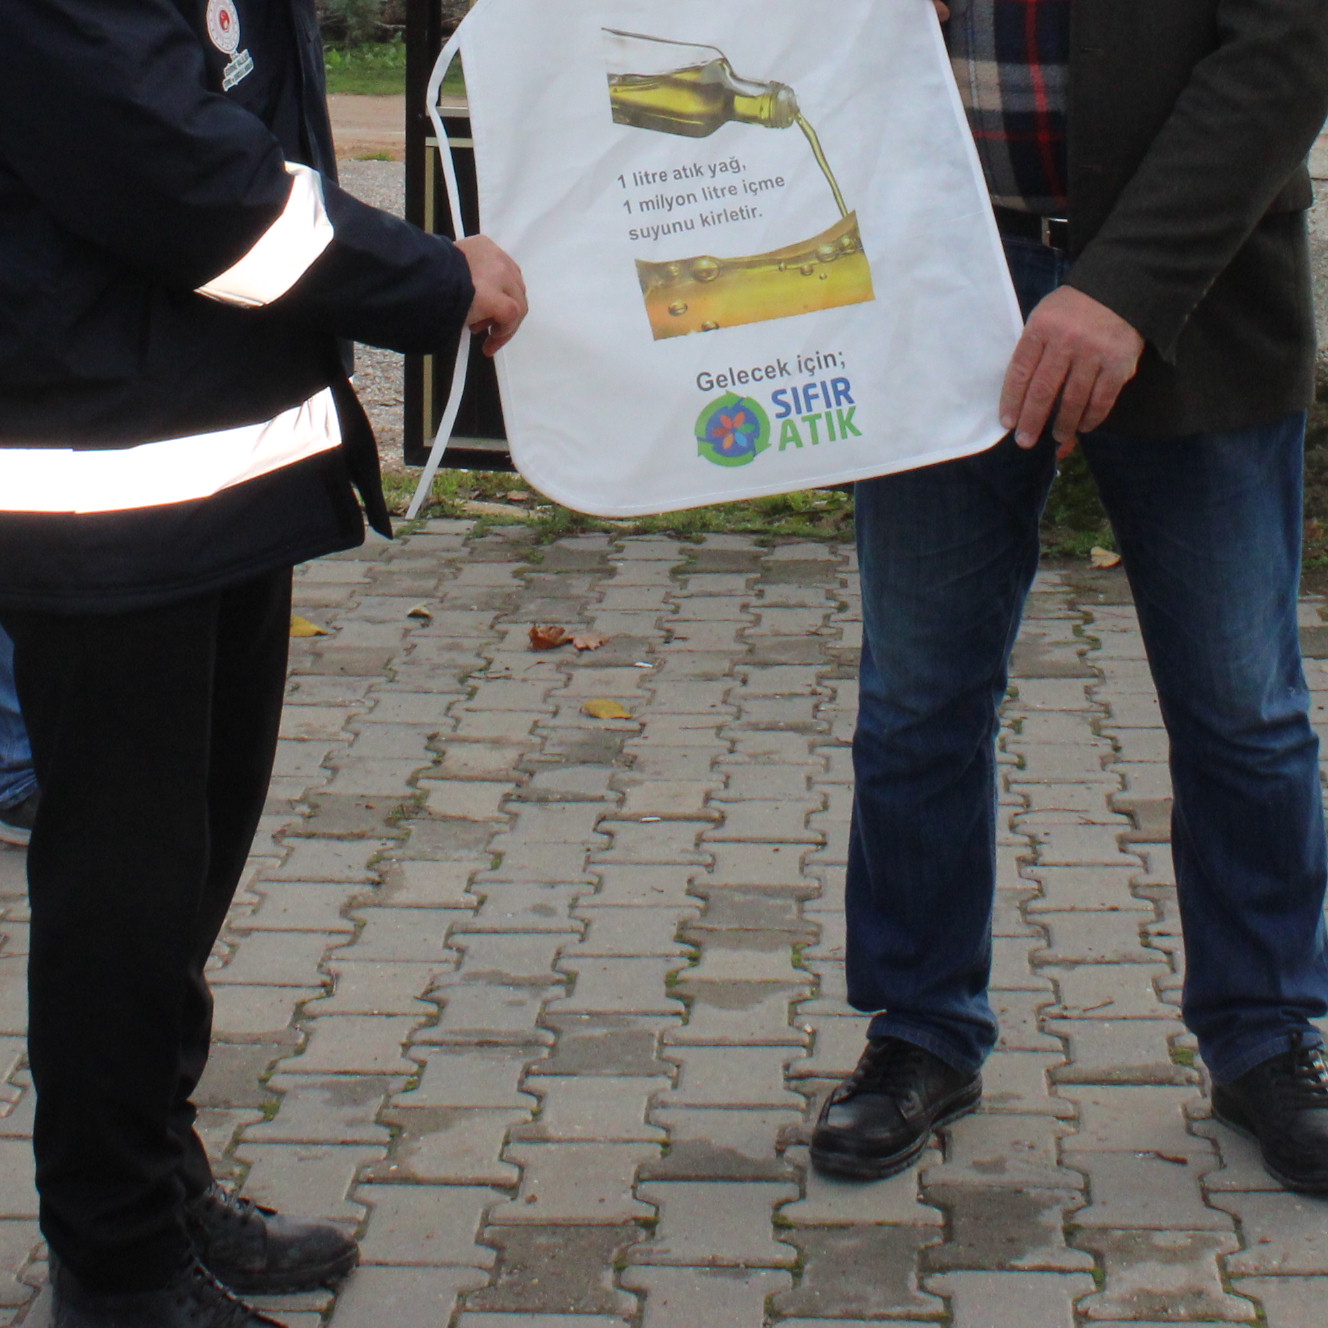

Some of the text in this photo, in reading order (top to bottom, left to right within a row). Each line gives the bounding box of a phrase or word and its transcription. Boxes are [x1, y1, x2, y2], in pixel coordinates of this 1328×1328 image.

[617, 156, 747, 189] 1 litre atık yağ,
[623, 175, 785, 214] 1 milyon litre içme
[629, 204, 763, 241] suyunu kirletir.
[696, 350, 846, 392] Gelecek için;
[771, 376, 855, 419] SIFIR
[778, 405, 863, 451] ATIK
